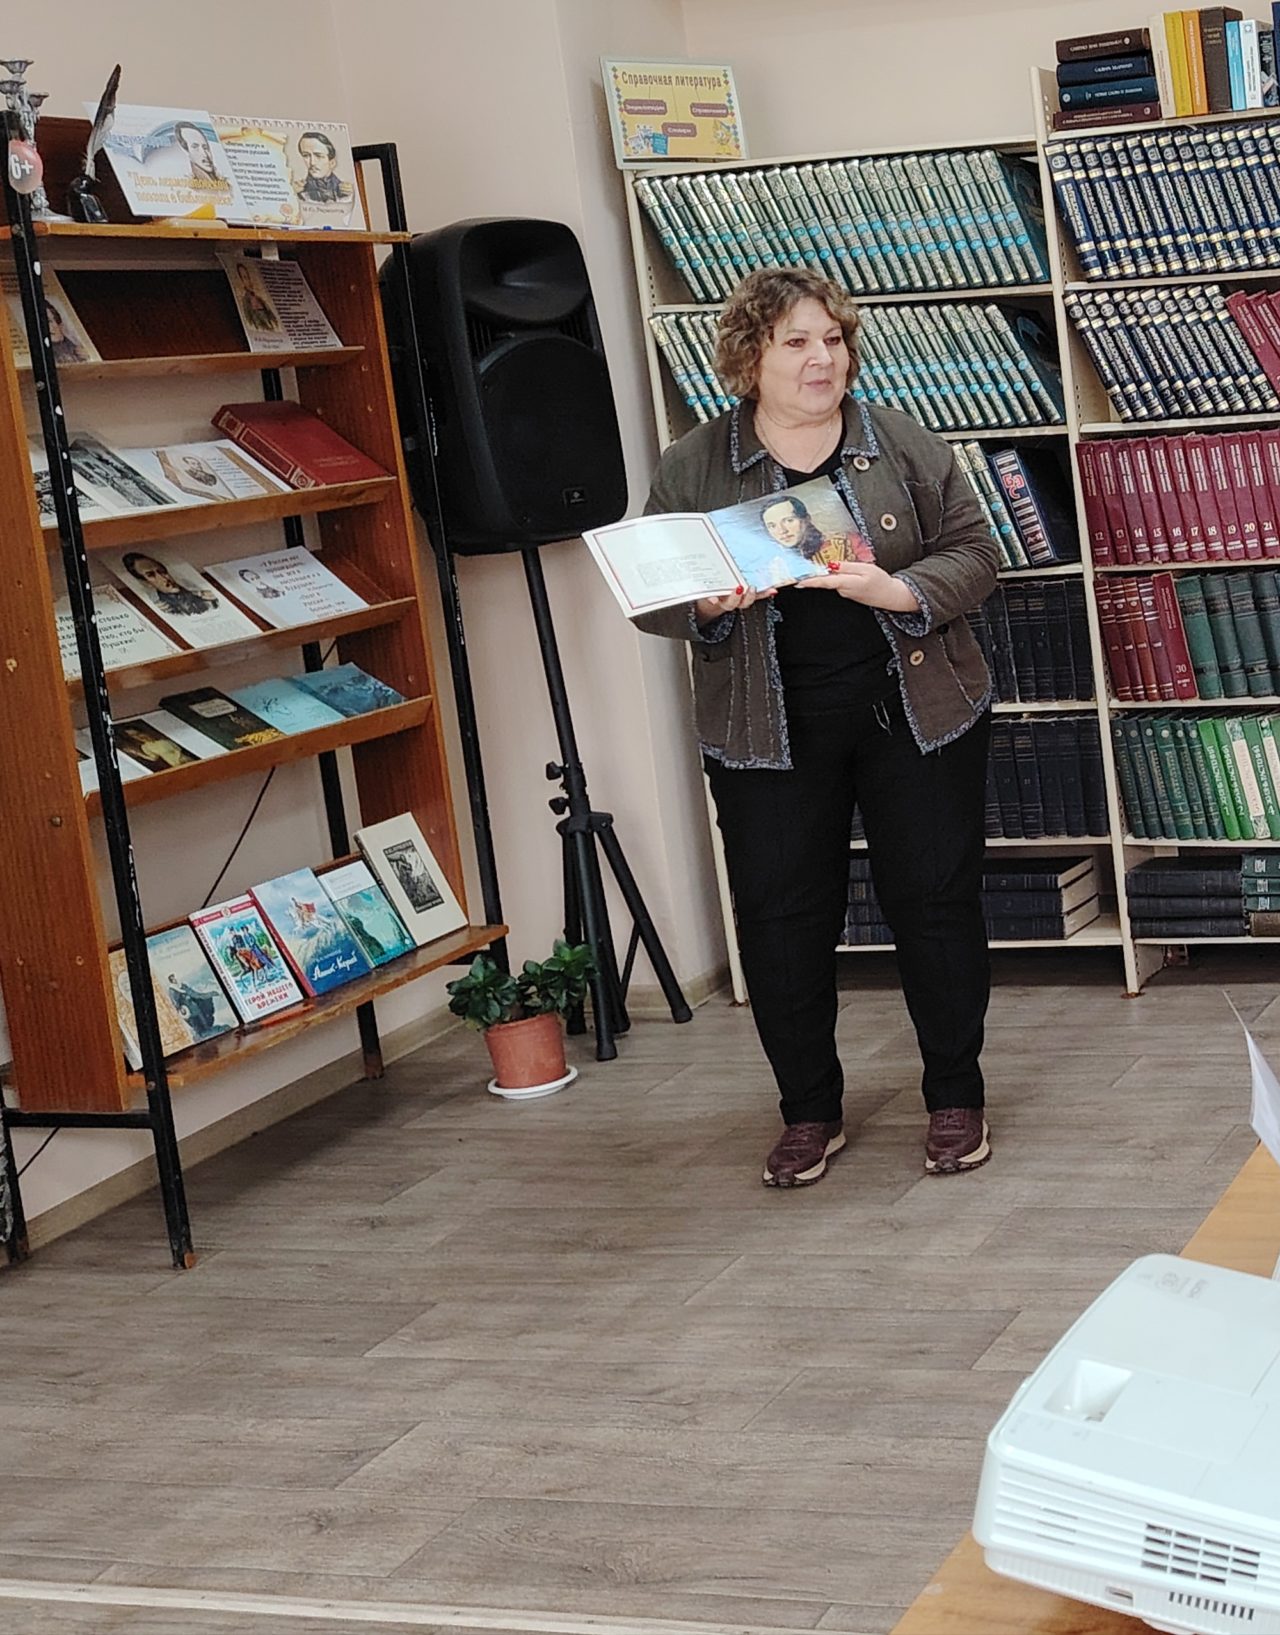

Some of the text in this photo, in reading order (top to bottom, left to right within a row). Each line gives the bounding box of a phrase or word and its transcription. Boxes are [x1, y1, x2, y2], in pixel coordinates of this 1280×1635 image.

[622, 71, 722, 90] Справочная литература
[11, 154, 34, 179] 6+
[1231, 241, 1237, 249] 9
[1247, 239, 1256, 248] 10
[1262, 238, 1272, 247] 11
[1167, 245, 1174, 253] 5
[1227, 525, 1237, 535] 19
[1244, 523, 1256, 534] 20
[1263, 520, 1273, 531] 21
[1134, 528, 1143, 538] 14
[1153, 527, 1162, 537] 15
[1172, 526, 1182, 537] 16
[1190, 526, 1200, 536] 17
[1207, 526, 1217, 536] 18
[1176, 664, 1187, 673] 30
[1237, 806, 1245, 816] 2
[1267, 805, 1275, 815] 4
